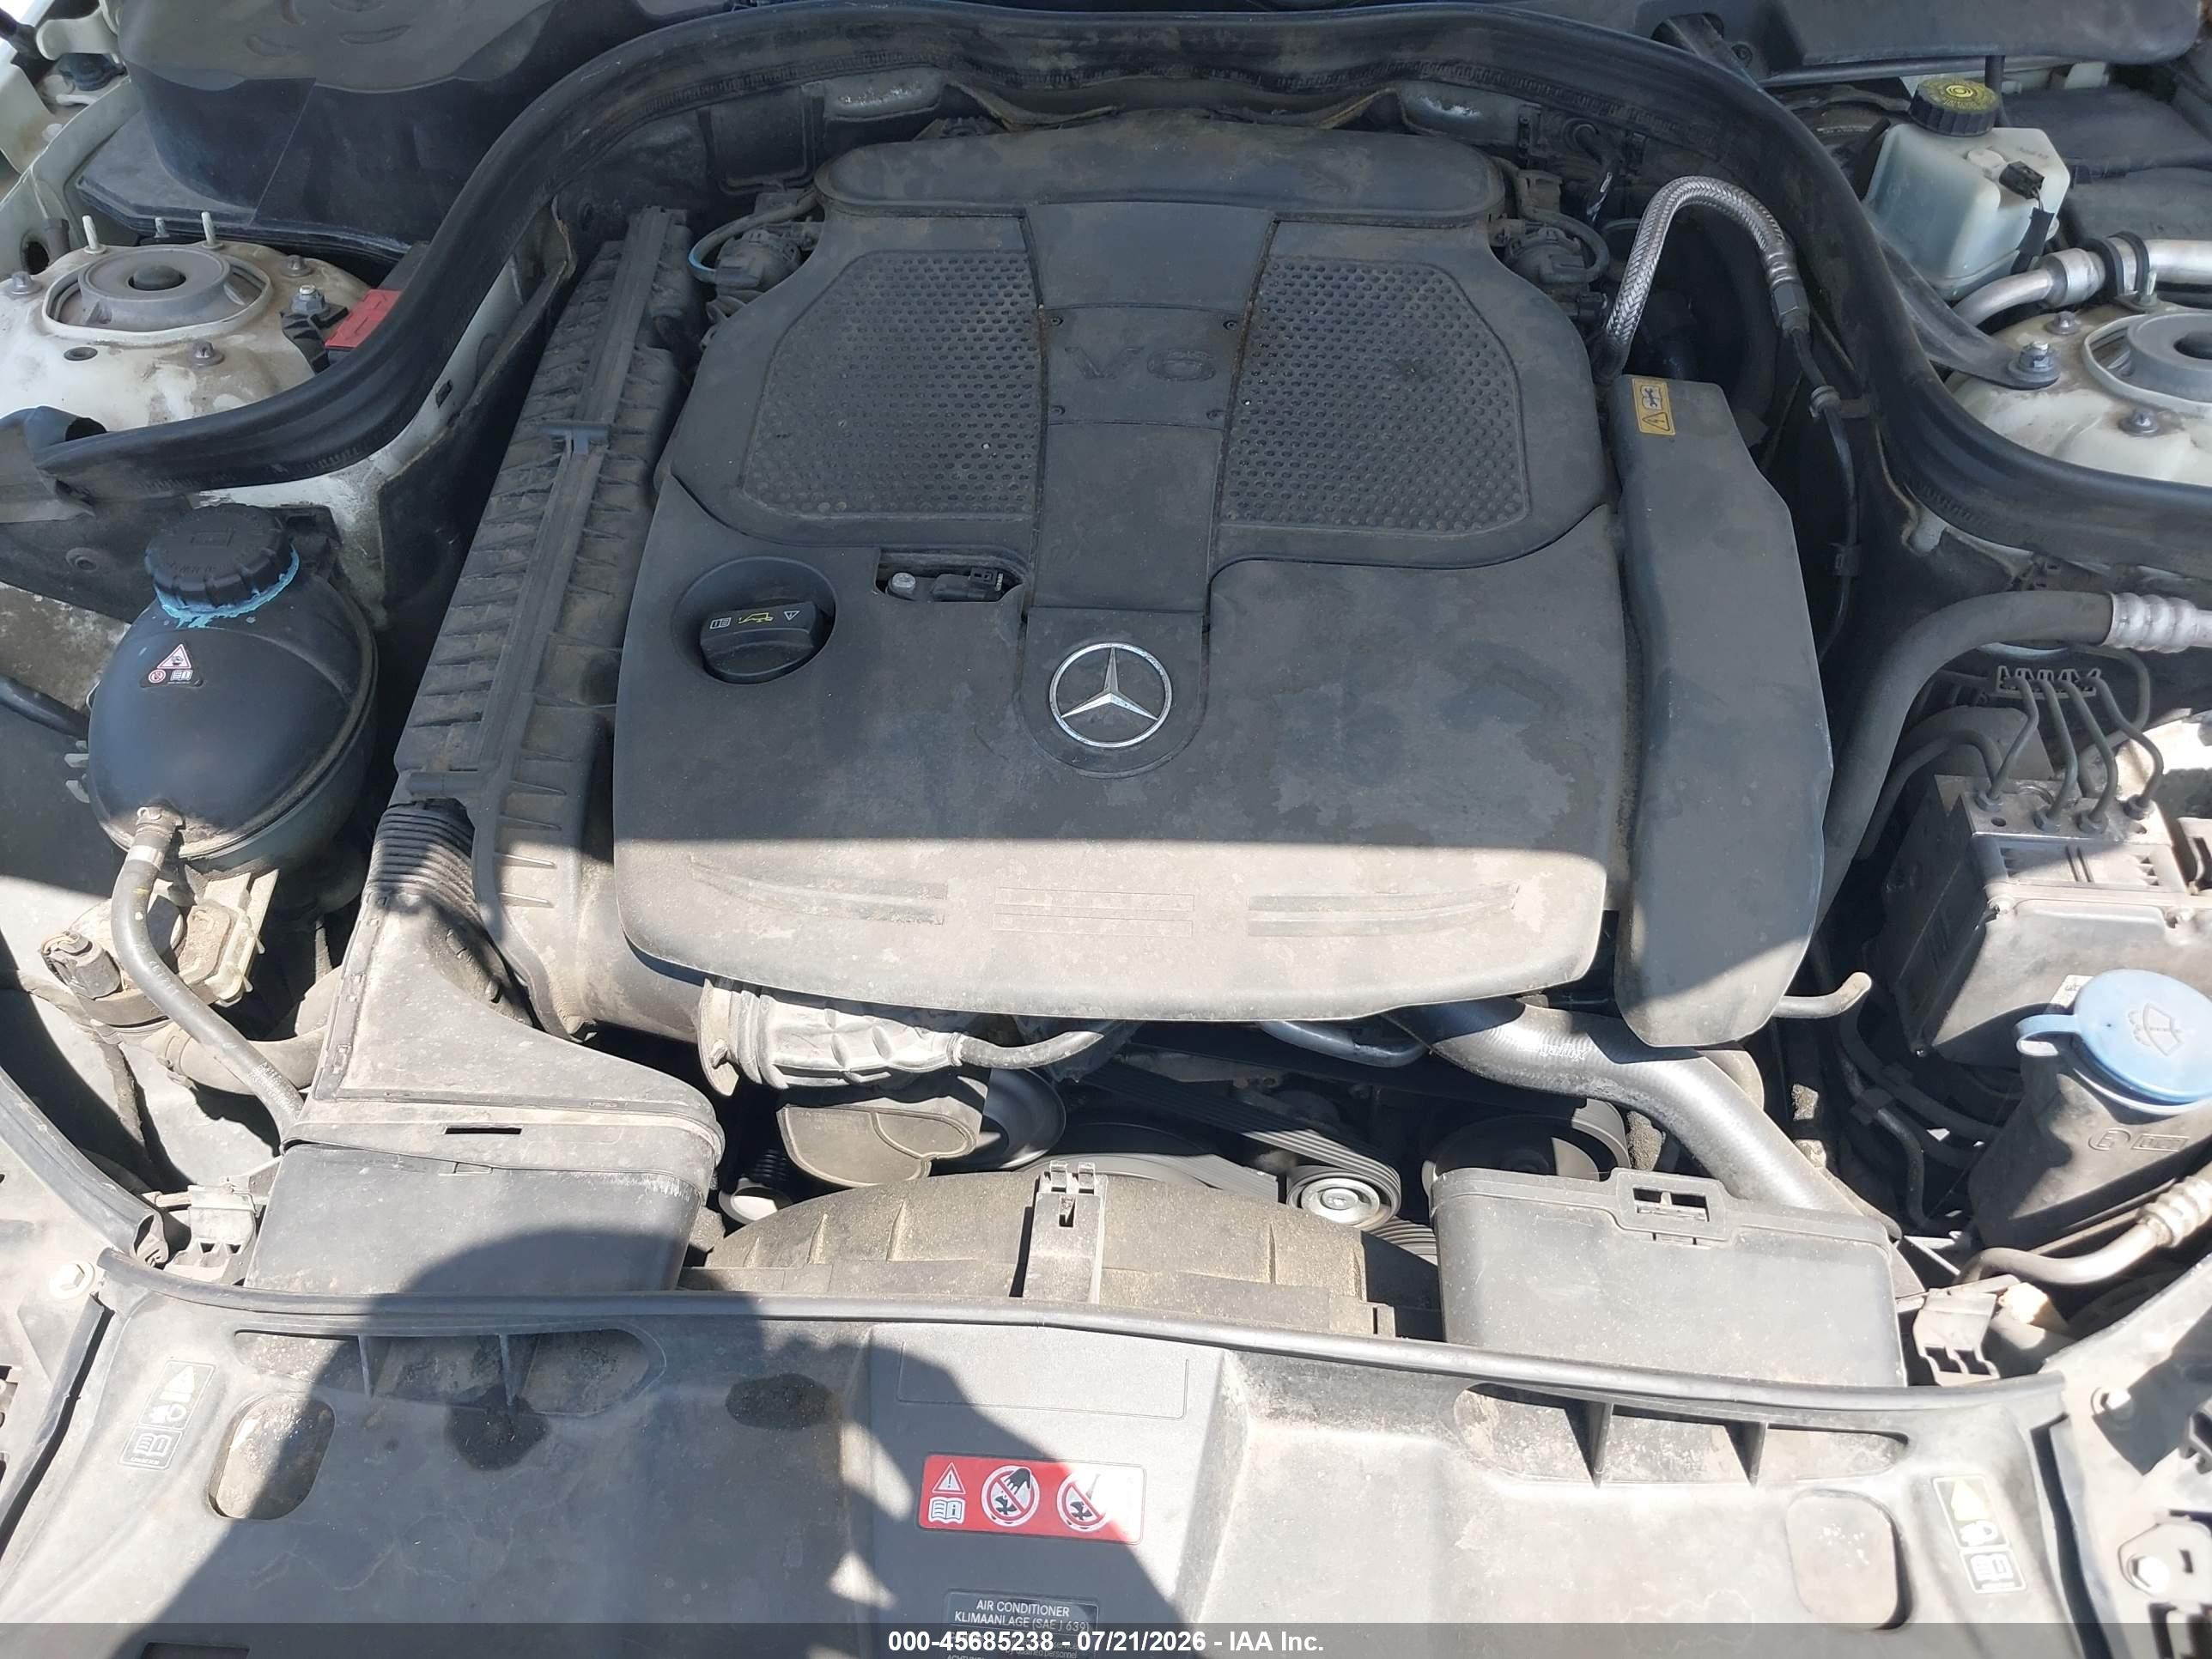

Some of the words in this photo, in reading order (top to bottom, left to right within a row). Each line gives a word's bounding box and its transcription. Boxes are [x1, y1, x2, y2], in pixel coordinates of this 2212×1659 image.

[975, 1600, 994, 1611] AIR
[996, 1601, 1071, 1617] CONDITIONER
[954, 1611, 1030, 1628] KLIMAANLAGE
[1032, 1618, 1057, 1630] (SAE
[1066, 1620, 1090, 1632] 639)
